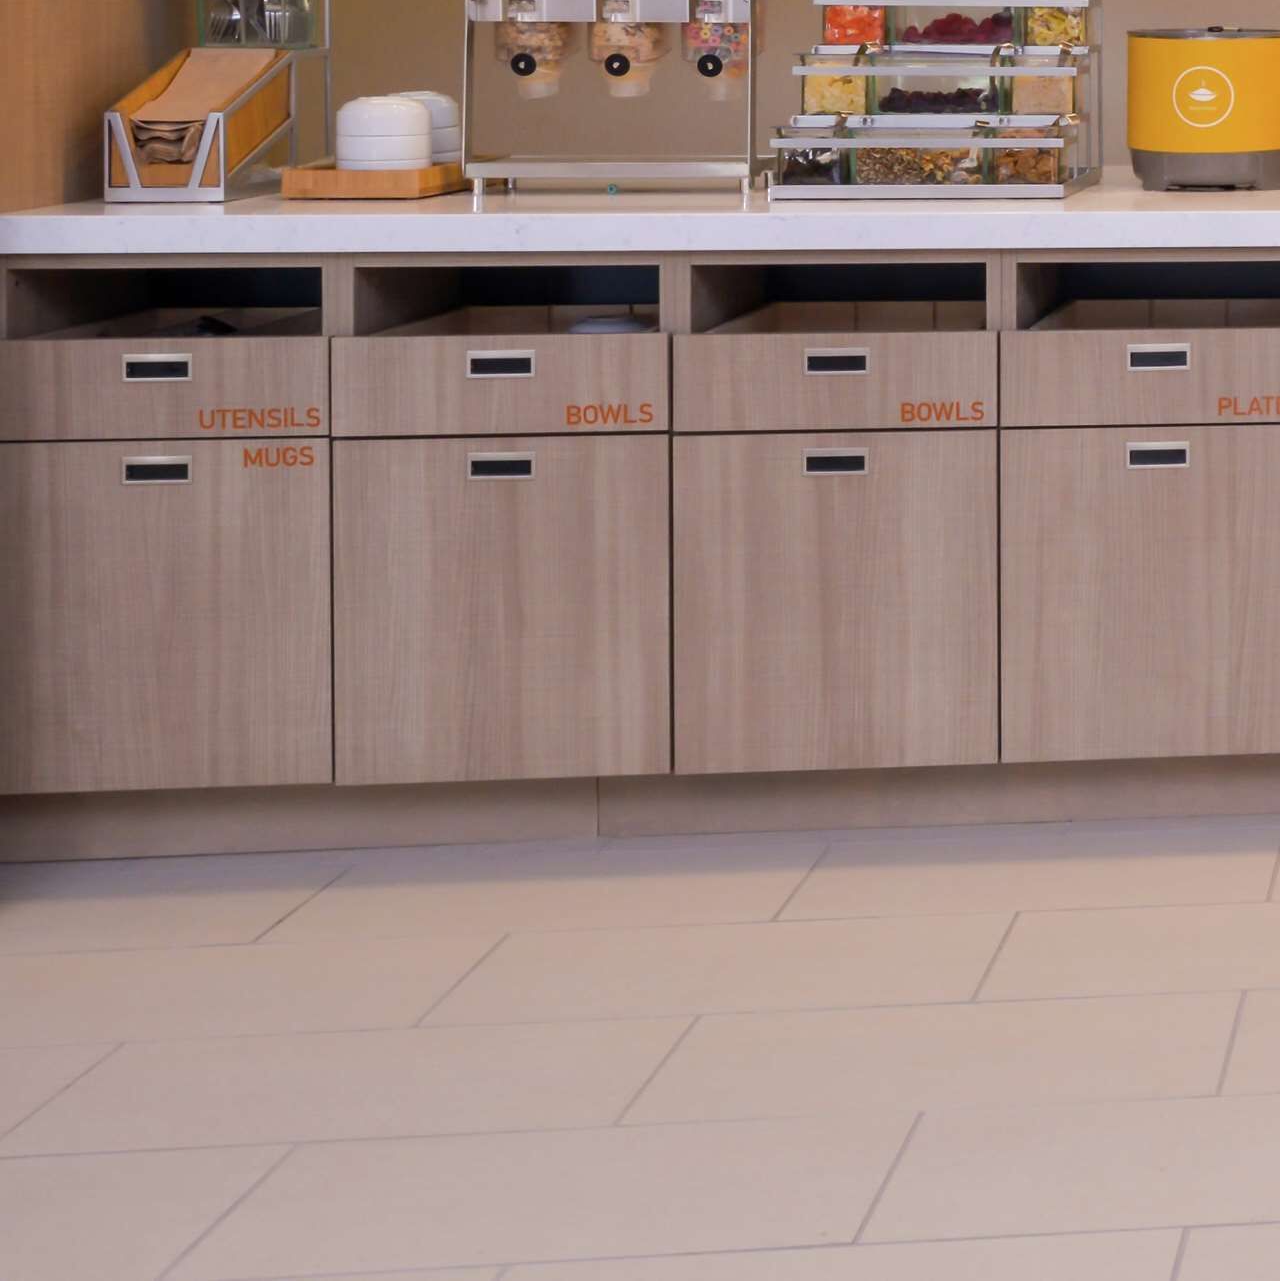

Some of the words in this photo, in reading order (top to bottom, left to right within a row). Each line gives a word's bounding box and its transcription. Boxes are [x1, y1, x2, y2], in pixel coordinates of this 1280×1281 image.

[198, 407, 321, 430] UTENSILS
[565, 403, 654, 426] BOWLS
[900, 401, 985, 423] BOWLS
[242, 446, 315, 468] MUGS
